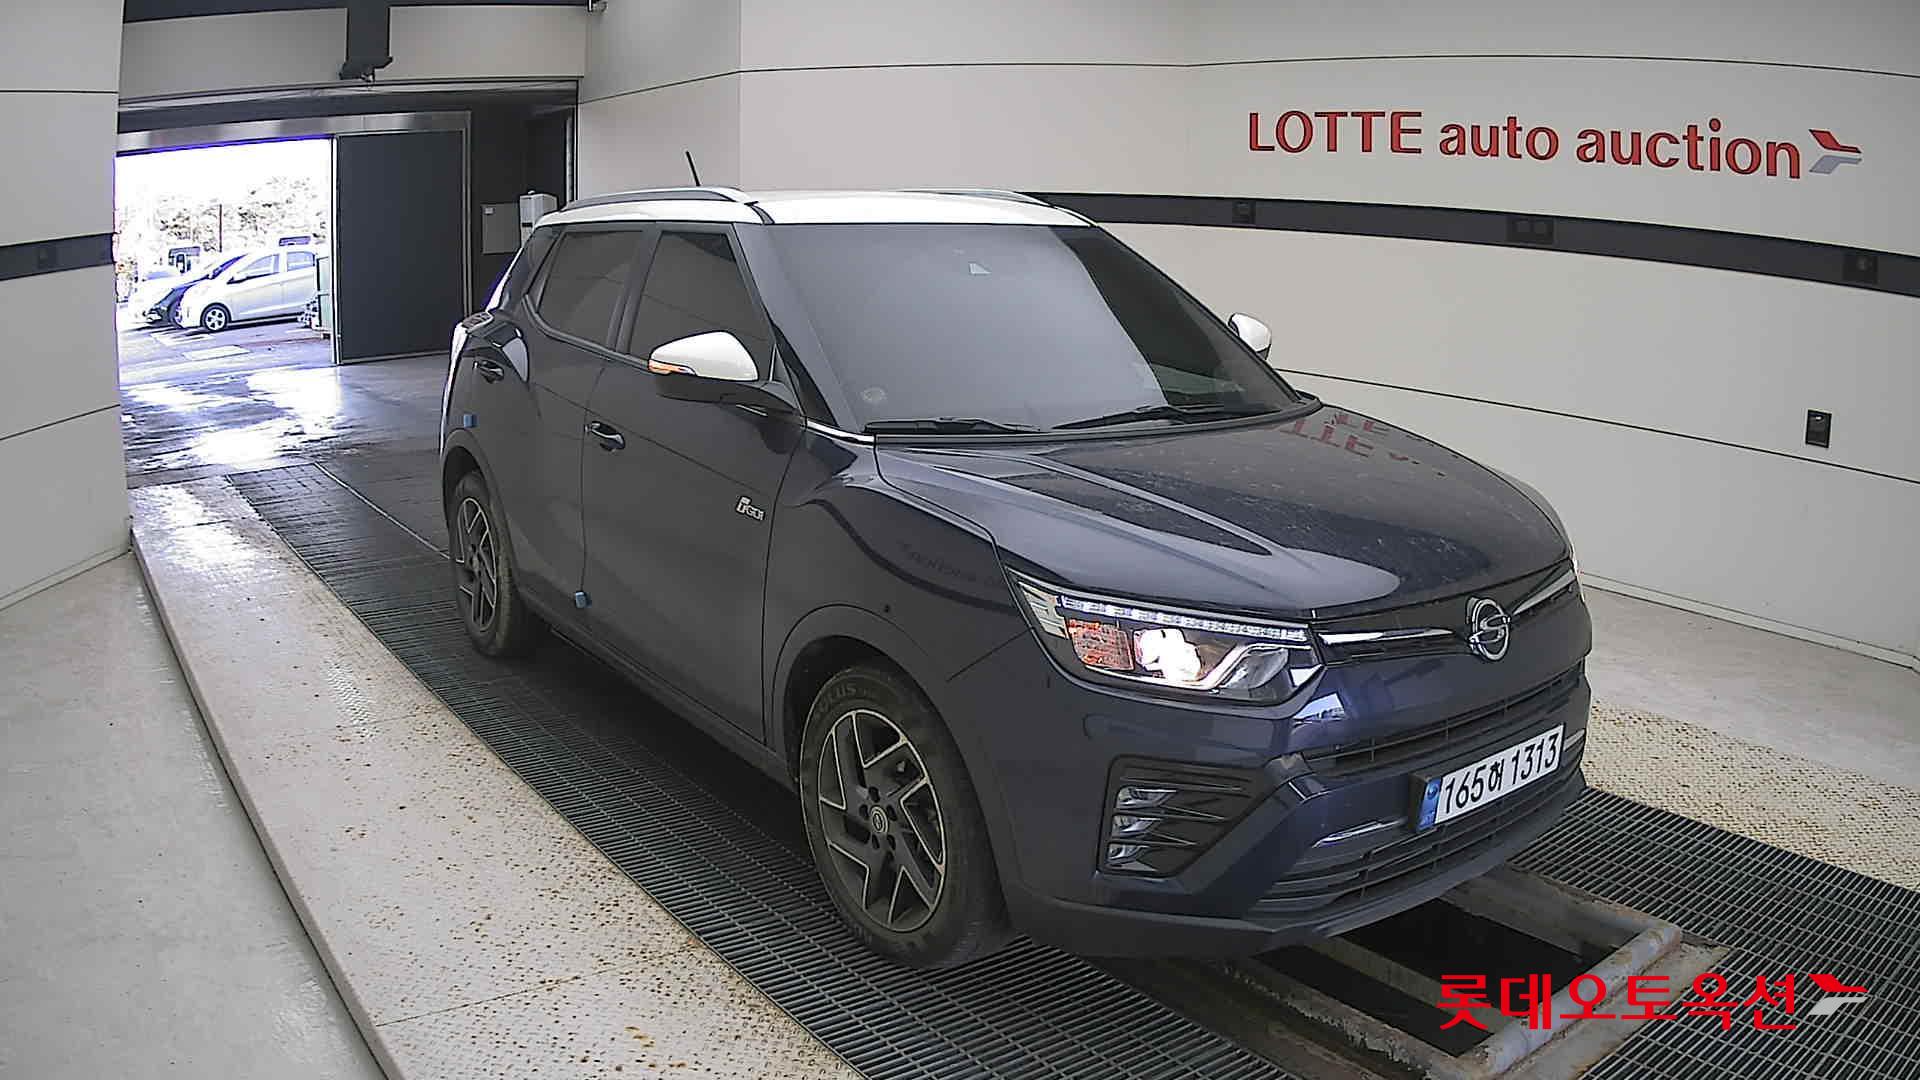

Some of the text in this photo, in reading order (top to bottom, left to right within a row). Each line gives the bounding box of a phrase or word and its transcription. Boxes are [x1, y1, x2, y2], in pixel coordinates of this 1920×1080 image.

[1248, 110, 1801, 179] LOTTE auto auction
[1445, 732, 1559, 814] 165허 1313
